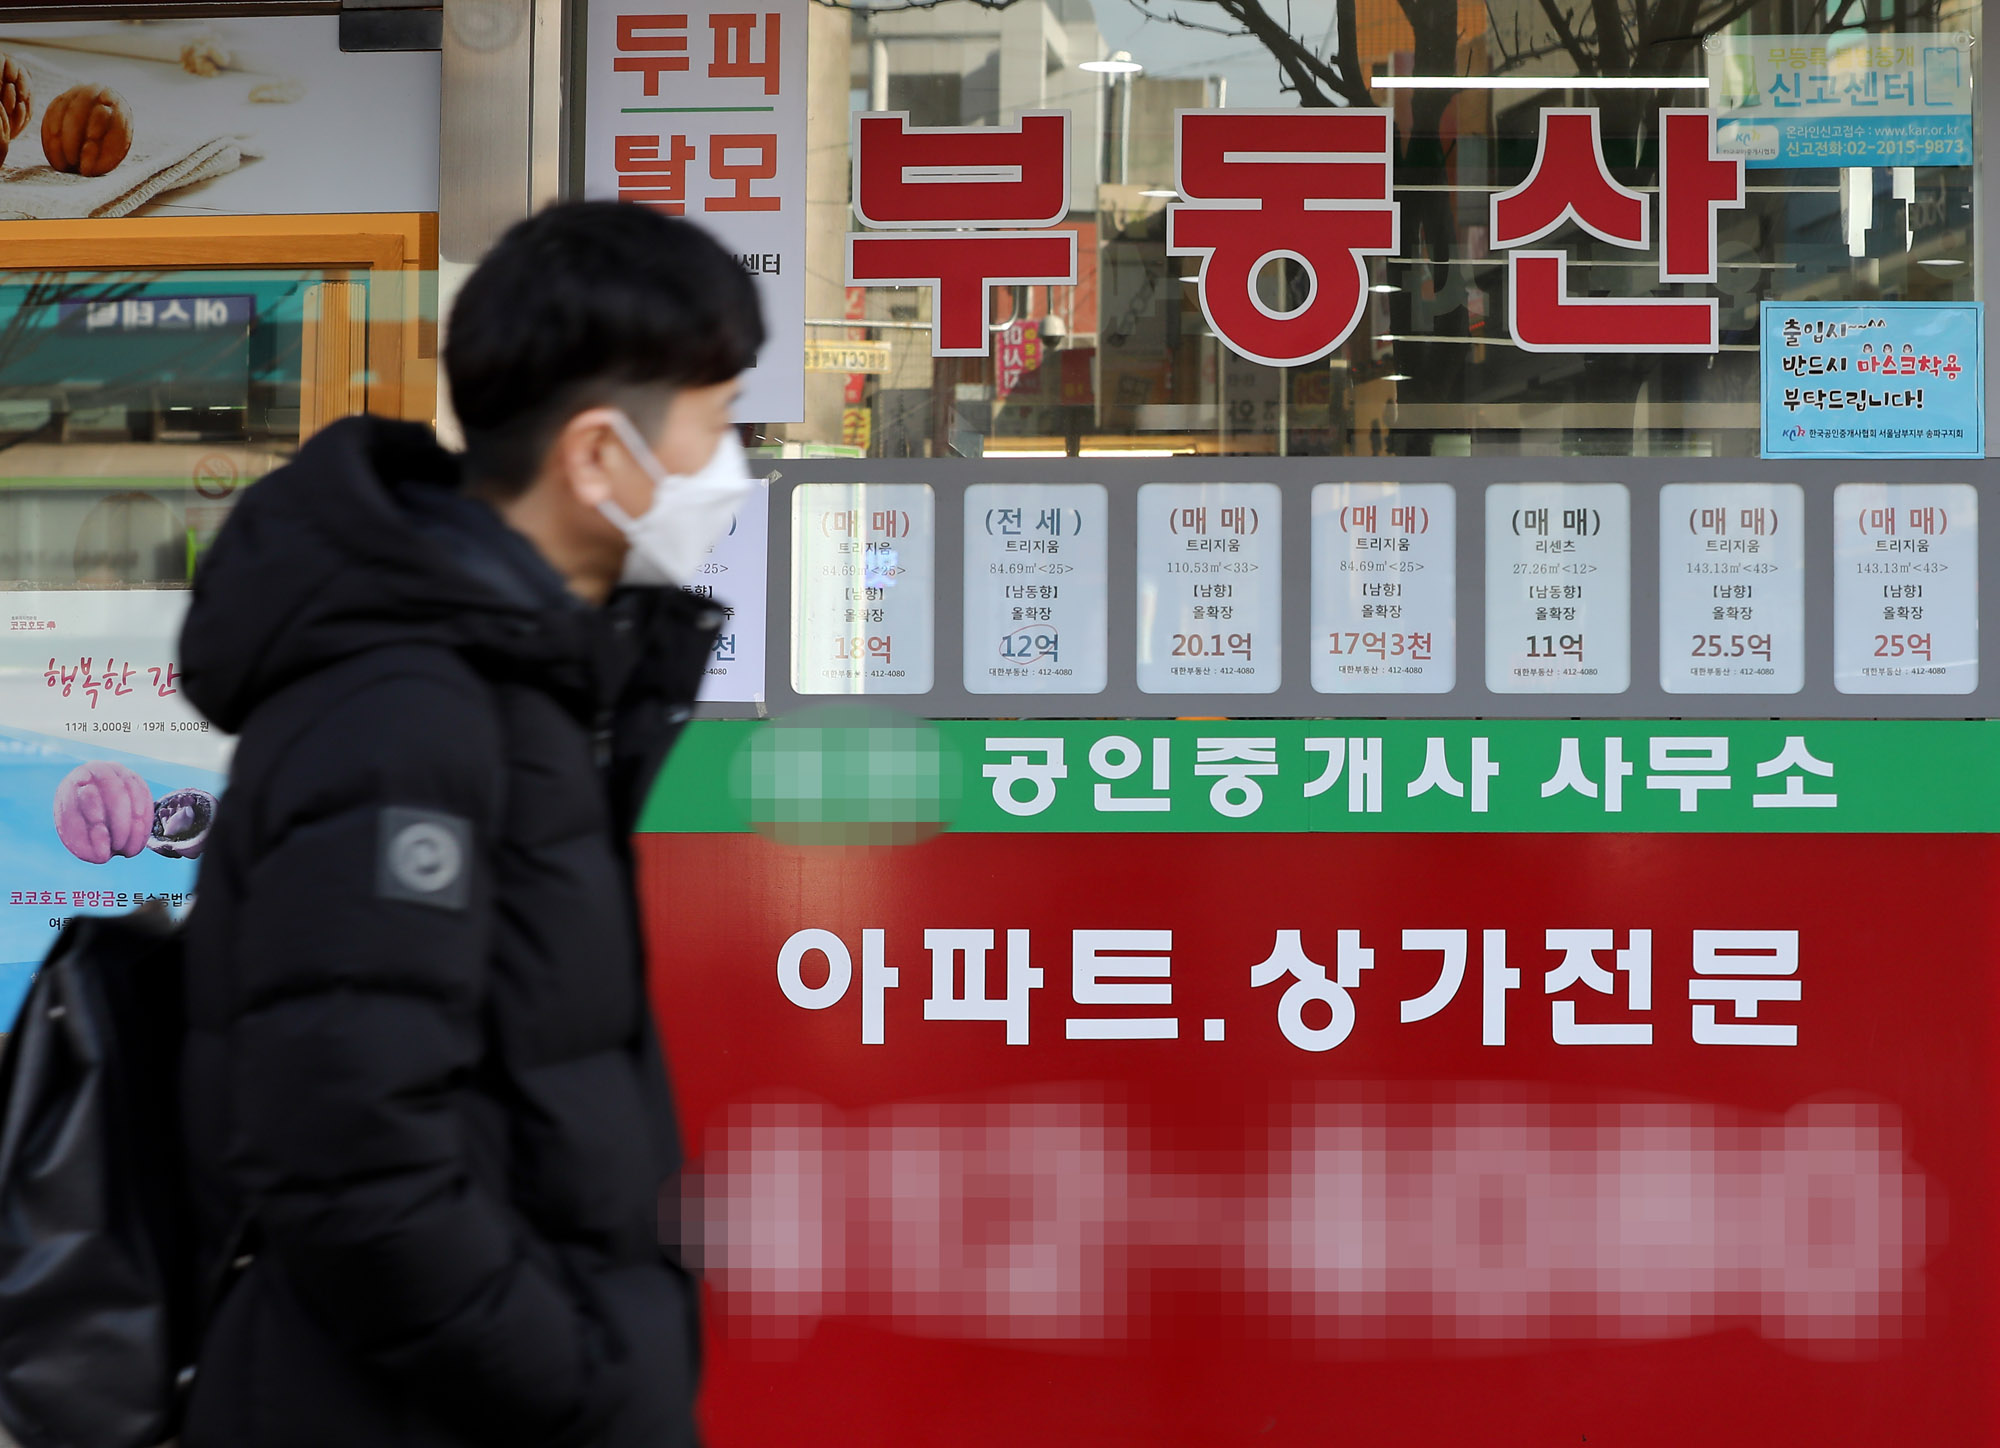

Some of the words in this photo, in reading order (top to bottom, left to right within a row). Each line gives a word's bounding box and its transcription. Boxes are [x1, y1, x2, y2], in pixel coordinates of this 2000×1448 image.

[614, 13, 780, 96] 두피
[1768, 48, 1829, 68] 무등록
[1768, 71, 1914, 107] 신고센터
[1786, 126, 1865, 138] 온라인신고접수
[1875, 124, 1959, 136] www.kar.or.kr
[615, 134, 781, 216] 탈모
[845, 107, 1744, 367] 부동산
[731, 254, 780, 275] 센터
[1783, 355, 1847, 375] 반드시
[1858, 354, 1961, 379] 마스크착용
[1784, 388, 1923, 411] 부탁드립니다!
[1810, 429, 1876, 438] 한국공인중개사협회
[1879, 429, 1923, 438] 서울남부지부
[1926, 429, 1963, 438] 송파구지회
[838, 542, 892, 554] 트리지움
[1005, 540, 1059, 553] 트리지움
[1186, 539, 1240, 552] 트리지움
[1356, 538, 1410, 550] 트리지움
[1536, 540, 1576, 553] 리센츠
[1706, 540, 1759, 552] 트리지움
[1876, 540, 1929, 552] 트리지움
[844, 609, 884, 622] 올확장
[1011, 607, 1052, 620] 올확장
[1192, 606, 1233, 619] 올확장
[1362, 605, 1402, 618] 올확장
[1536, 607, 1576, 620] 올확장
[1712, 607, 1753, 620] 올확장
[1883, 606, 1923, 619] 올확장
[835, 636, 891, 663] 18억
[1002, 634, 1058, 662] 12억
[1172, 633, 1251, 661] 20.1억
[1329, 632, 1431, 660] 17억3천
[1527, 634, 1582, 662] 11억
[1691, 634, 1770, 662] 25.5억
[1874, 633, 1931, 661] 25억
[822, 670, 860, 678] 대한부동산
[1339, 666, 1378, 674] 대한부동산
[1514, 668, 1553, 676] 대한부동산
[1862, 668, 1901, 676] 대한부동산
[44, 658, 136, 709] 행복한
[66, 723, 87, 732] 11개
[93, 722, 131, 732] 3,000원
[144, 722, 164, 732] 19개
[171, 722, 208, 732] 5,000원
[983, 735, 1499, 817] 공인중개사
[1541, 736, 1837, 812] 사무소
[10, 891, 67, 905] 코코호도
[72, 891, 128, 907] 팥앙금은
